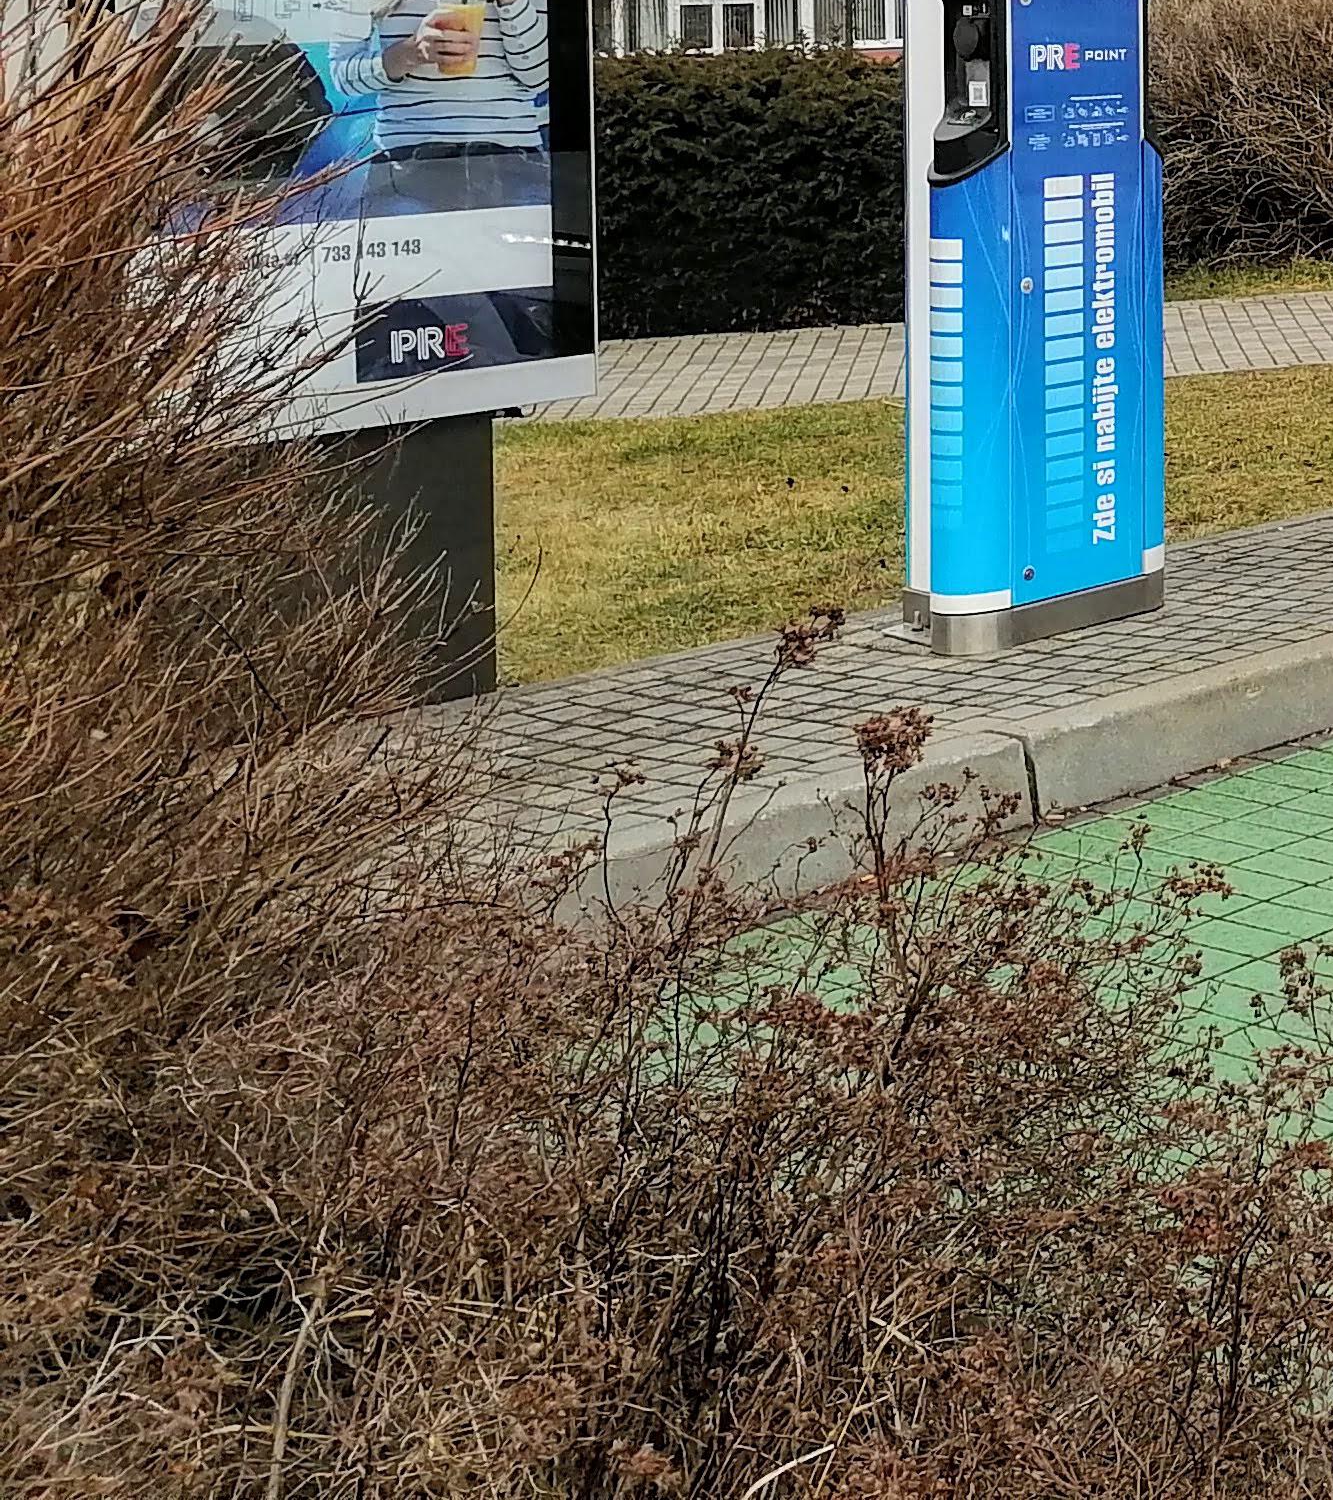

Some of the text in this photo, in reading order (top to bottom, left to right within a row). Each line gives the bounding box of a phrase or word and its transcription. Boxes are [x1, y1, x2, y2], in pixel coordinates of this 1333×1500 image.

[1030, 43, 1127, 71] PRE POINT
[321, 244, 351, 264] 733
[391, 238, 422, 257] 143
[390, 323, 470, 364] PRE
[1091, 172, 1119, 546] Zde si nabijte elektromobil
